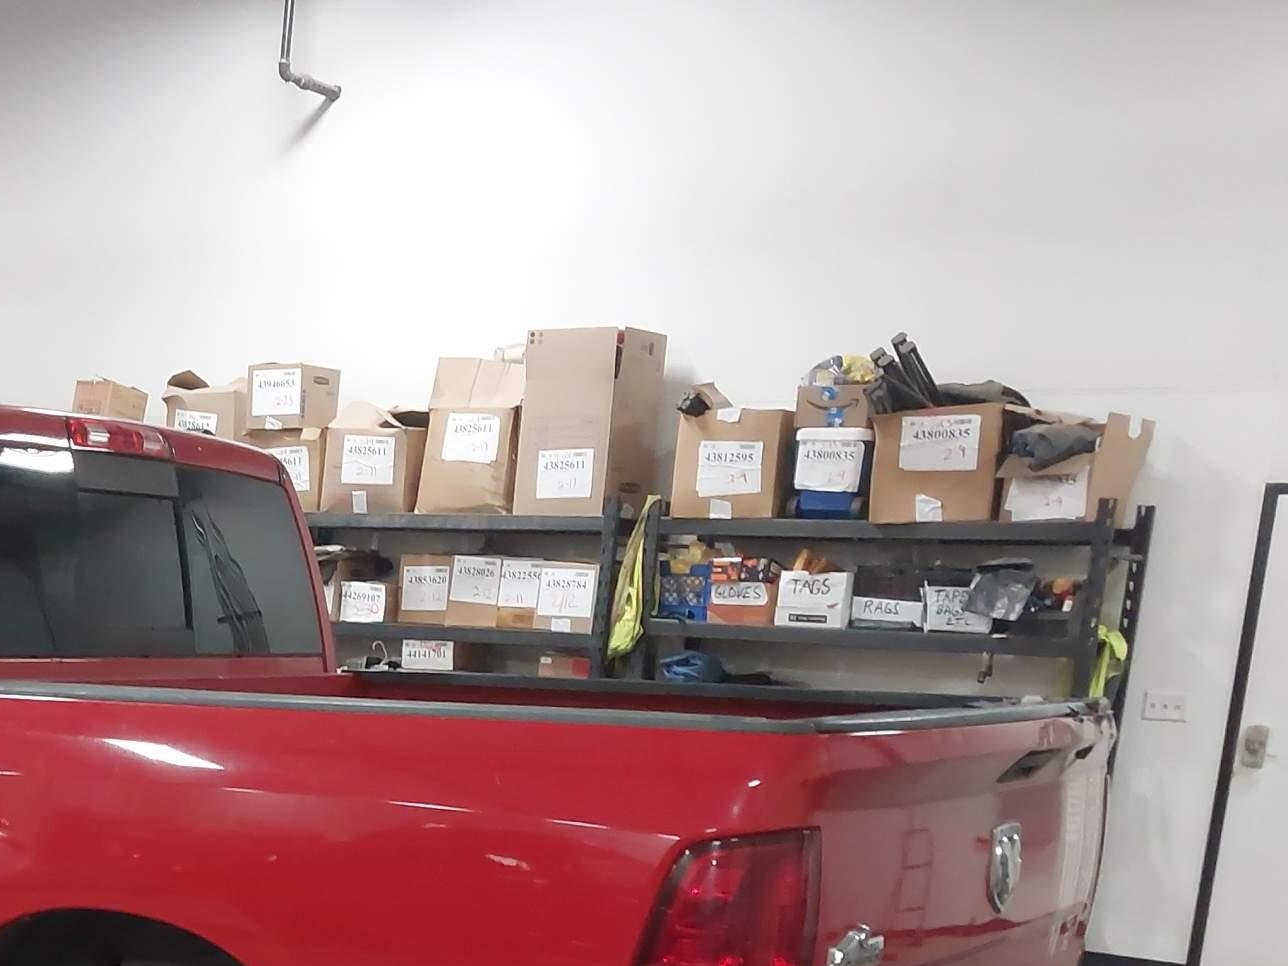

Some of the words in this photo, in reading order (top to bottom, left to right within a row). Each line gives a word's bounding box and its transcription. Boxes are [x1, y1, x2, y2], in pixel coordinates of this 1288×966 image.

[454, 423, 492, 433] 43825611
[913, 428, 971, 441] 43800835
[349, 445, 386, 457] 43825611
[705, 451, 754, 463] 43812595
[803, 449, 855, 461] 43800835
[544, 460, 585, 471] 43825611
[546, 579, 587, 590] 43828784
[791, 577, 832, 596] TAGS
[714, 585, 761, 600] GLOVES
[863, 599, 900, 616] RAGS
